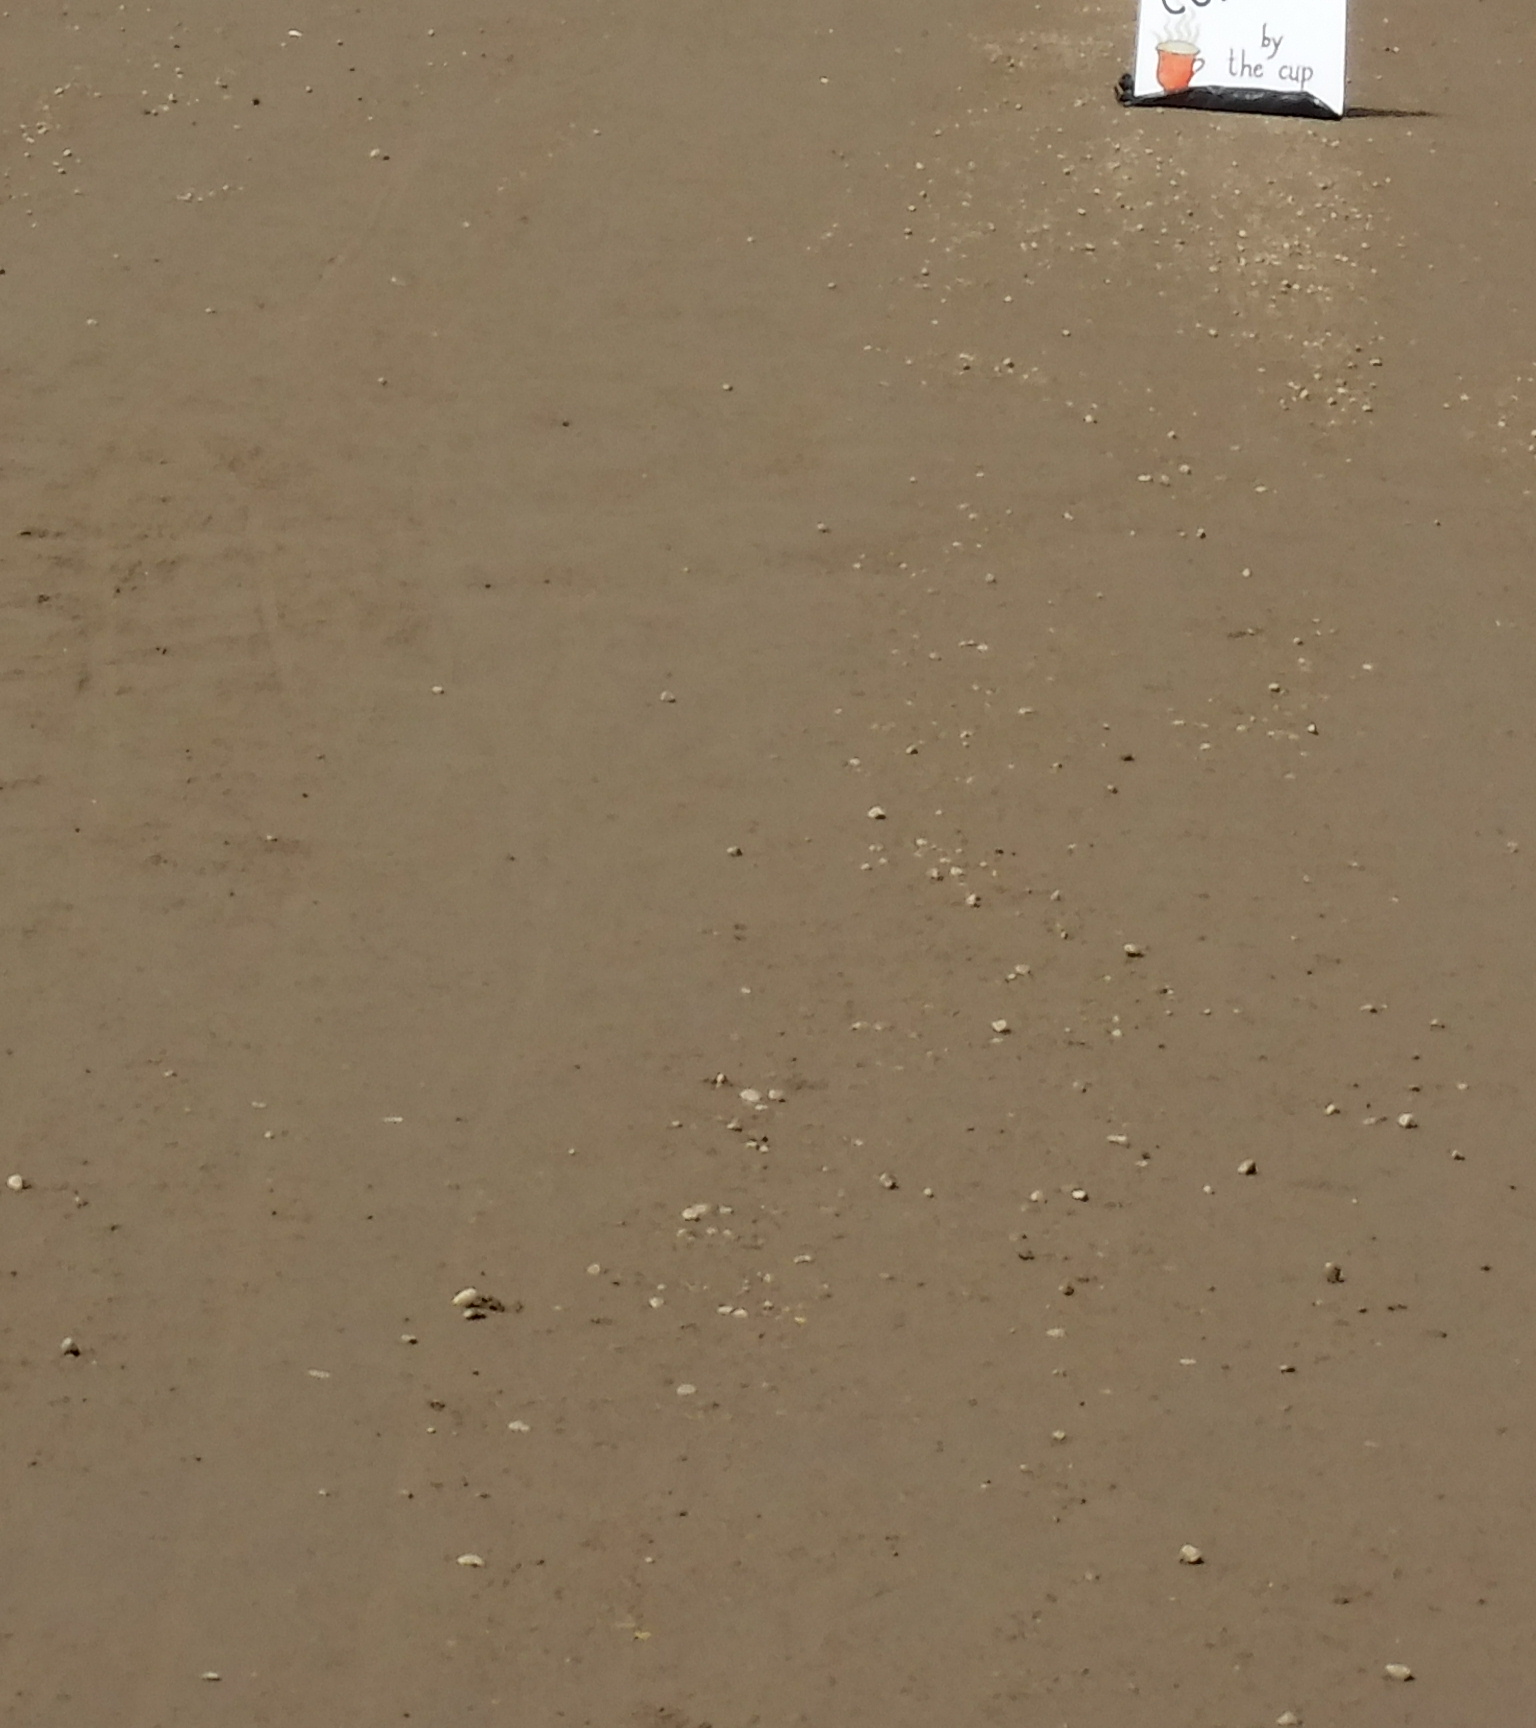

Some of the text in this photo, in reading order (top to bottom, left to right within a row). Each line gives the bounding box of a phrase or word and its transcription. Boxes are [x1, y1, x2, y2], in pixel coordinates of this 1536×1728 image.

[1261, 23, 1284, 60] by
[1229, 48, 1314, 91] the cup
